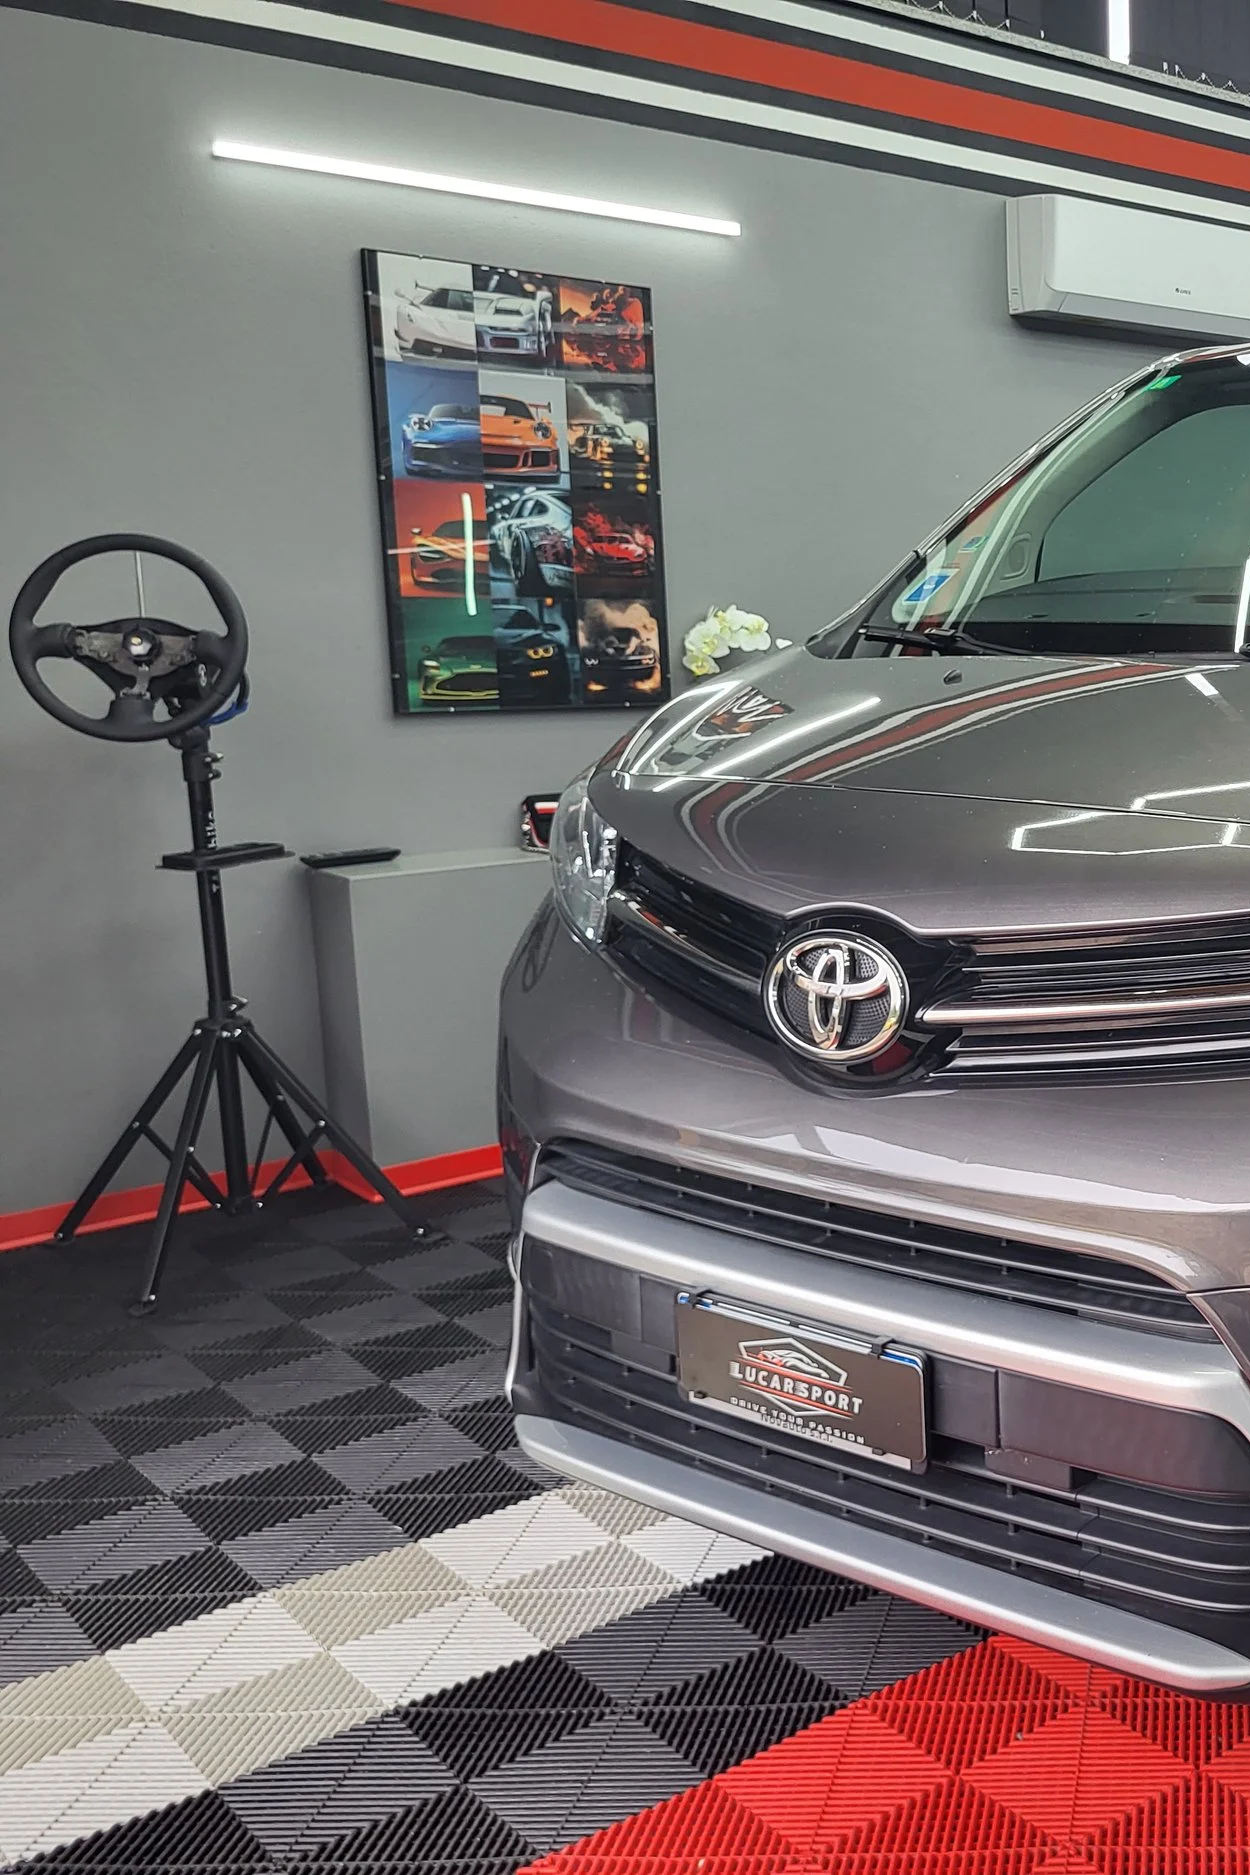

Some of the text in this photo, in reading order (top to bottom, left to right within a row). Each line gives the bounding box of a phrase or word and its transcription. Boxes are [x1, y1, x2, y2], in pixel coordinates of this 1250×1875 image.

[729, 1361, 863, 1414] LUCARSPORT
[729, 1396, 865, 1445] DRIVE YOUR PASSION
